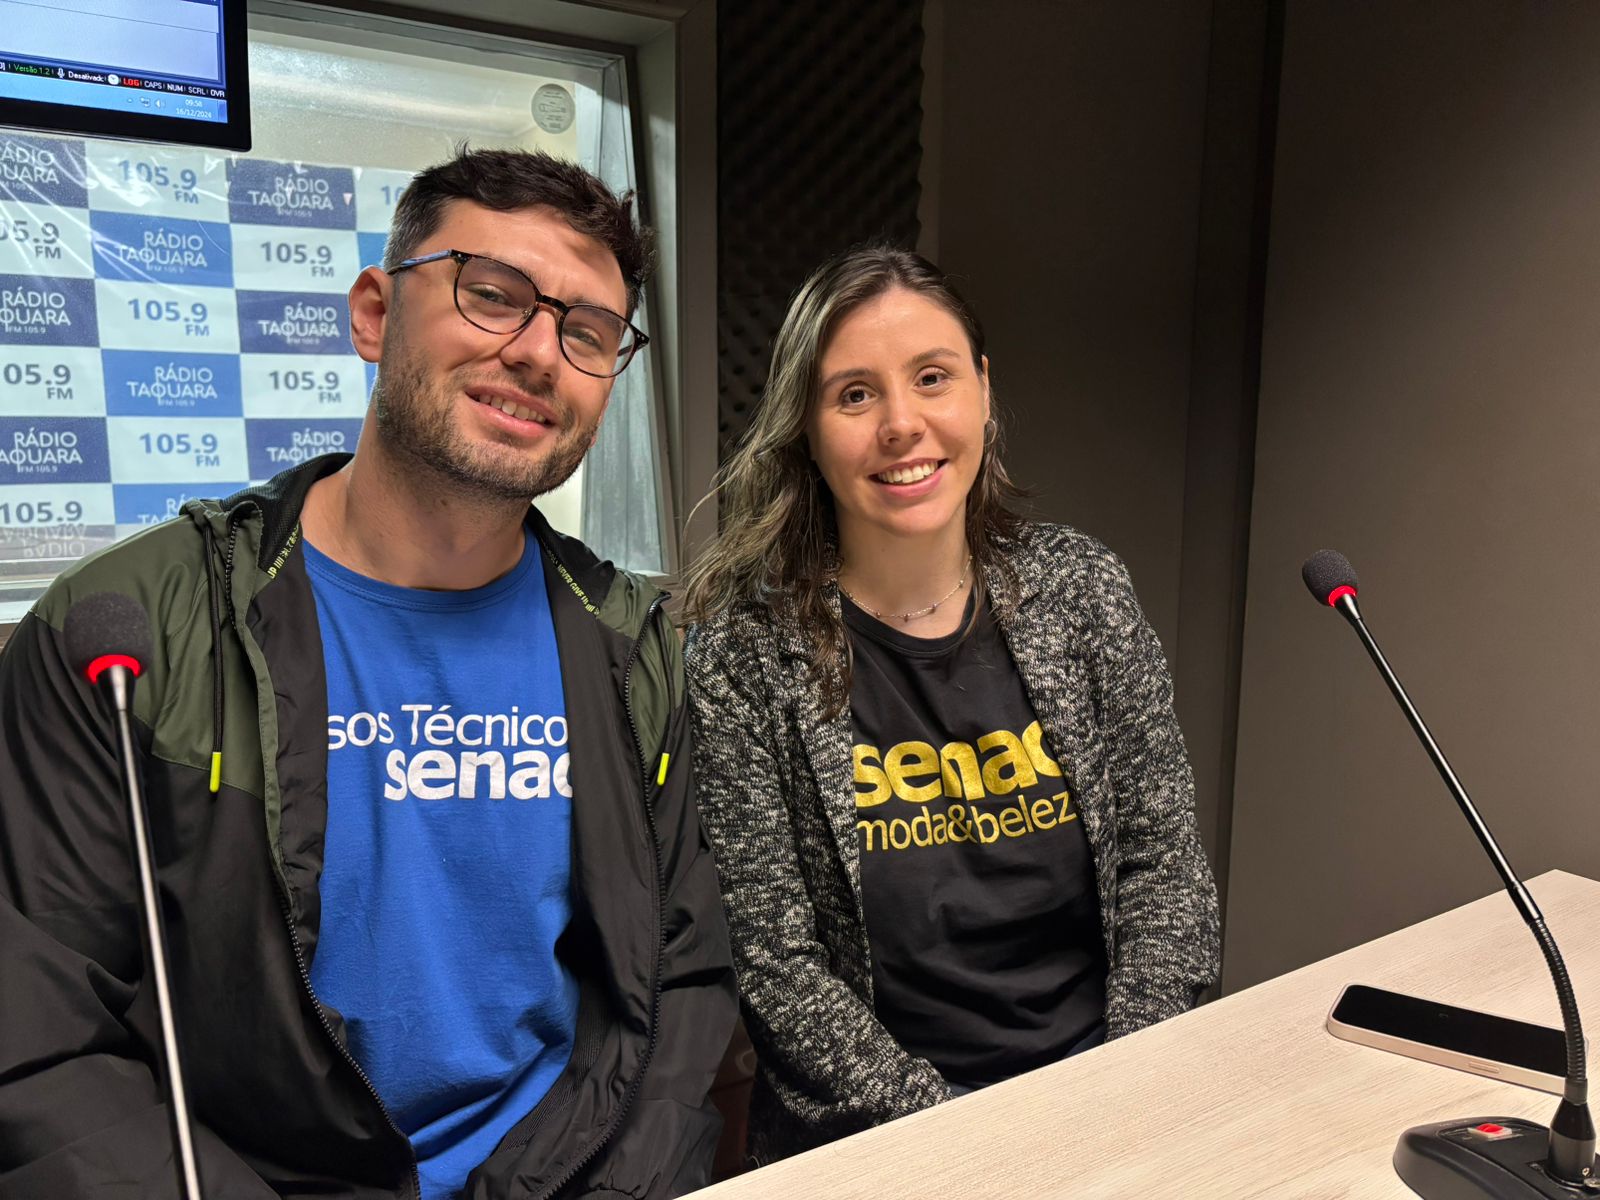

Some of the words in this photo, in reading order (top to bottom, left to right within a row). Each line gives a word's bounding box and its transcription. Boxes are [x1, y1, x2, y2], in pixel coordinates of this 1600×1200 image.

[123, 78, 140, 87] LOG
[144, 81, 162, 90] CAPS
[167, 83, 184, 92] NUM
[188, 86, 206, 95] SCRL
[210, 89, 225, 98] OVR
[0, 162, 60, 184] UARA
[118, 160, 198, 190] 105.9
[275, 174, 329, 194] RÁDIO
[174, 190, 199, 204] FM
[248, 190, 334, 212] TAQUARA
[144, 228, 203, 251] RÁDIO
[35, 246, 61, 259] FM
[118, 244, 208, 268] TAQUARA
[261, 241, 332, 265] 105.9
[311, 266, 334, 278] FM
[2, 286, 65, 308] RÁDIO
[128, 298, 208, 323] 105.9
[284, 302, 337, 321] RÁDIO
[185, 325, 209, 337] FM
[258, 320, 340, 338] TAQUARA
[155, 362, 213, 383] RÁDIO
[268, 371, 340, 390] 105.9
[47, 387, 73, 400] FM
[126, 381, 218, 400] TAQUARA
[318, 391, 341, 403] FM
[14, 427, 77, 448] RÁDIO
[139, 433, 218, 454] 105.9
[292, 428, 345, 446] RÁDIO
[196, 455, 220, 467] FM
[266, 447, 346, 462] TAQUA
[0, 501, 82, 524] 105.9
[327, 711, 395, 750] sos
[401, 704, 569, 747] Técnico
[853, 720, 1064, 808] senac
[856, 792, 1077, 851] moda&belez
